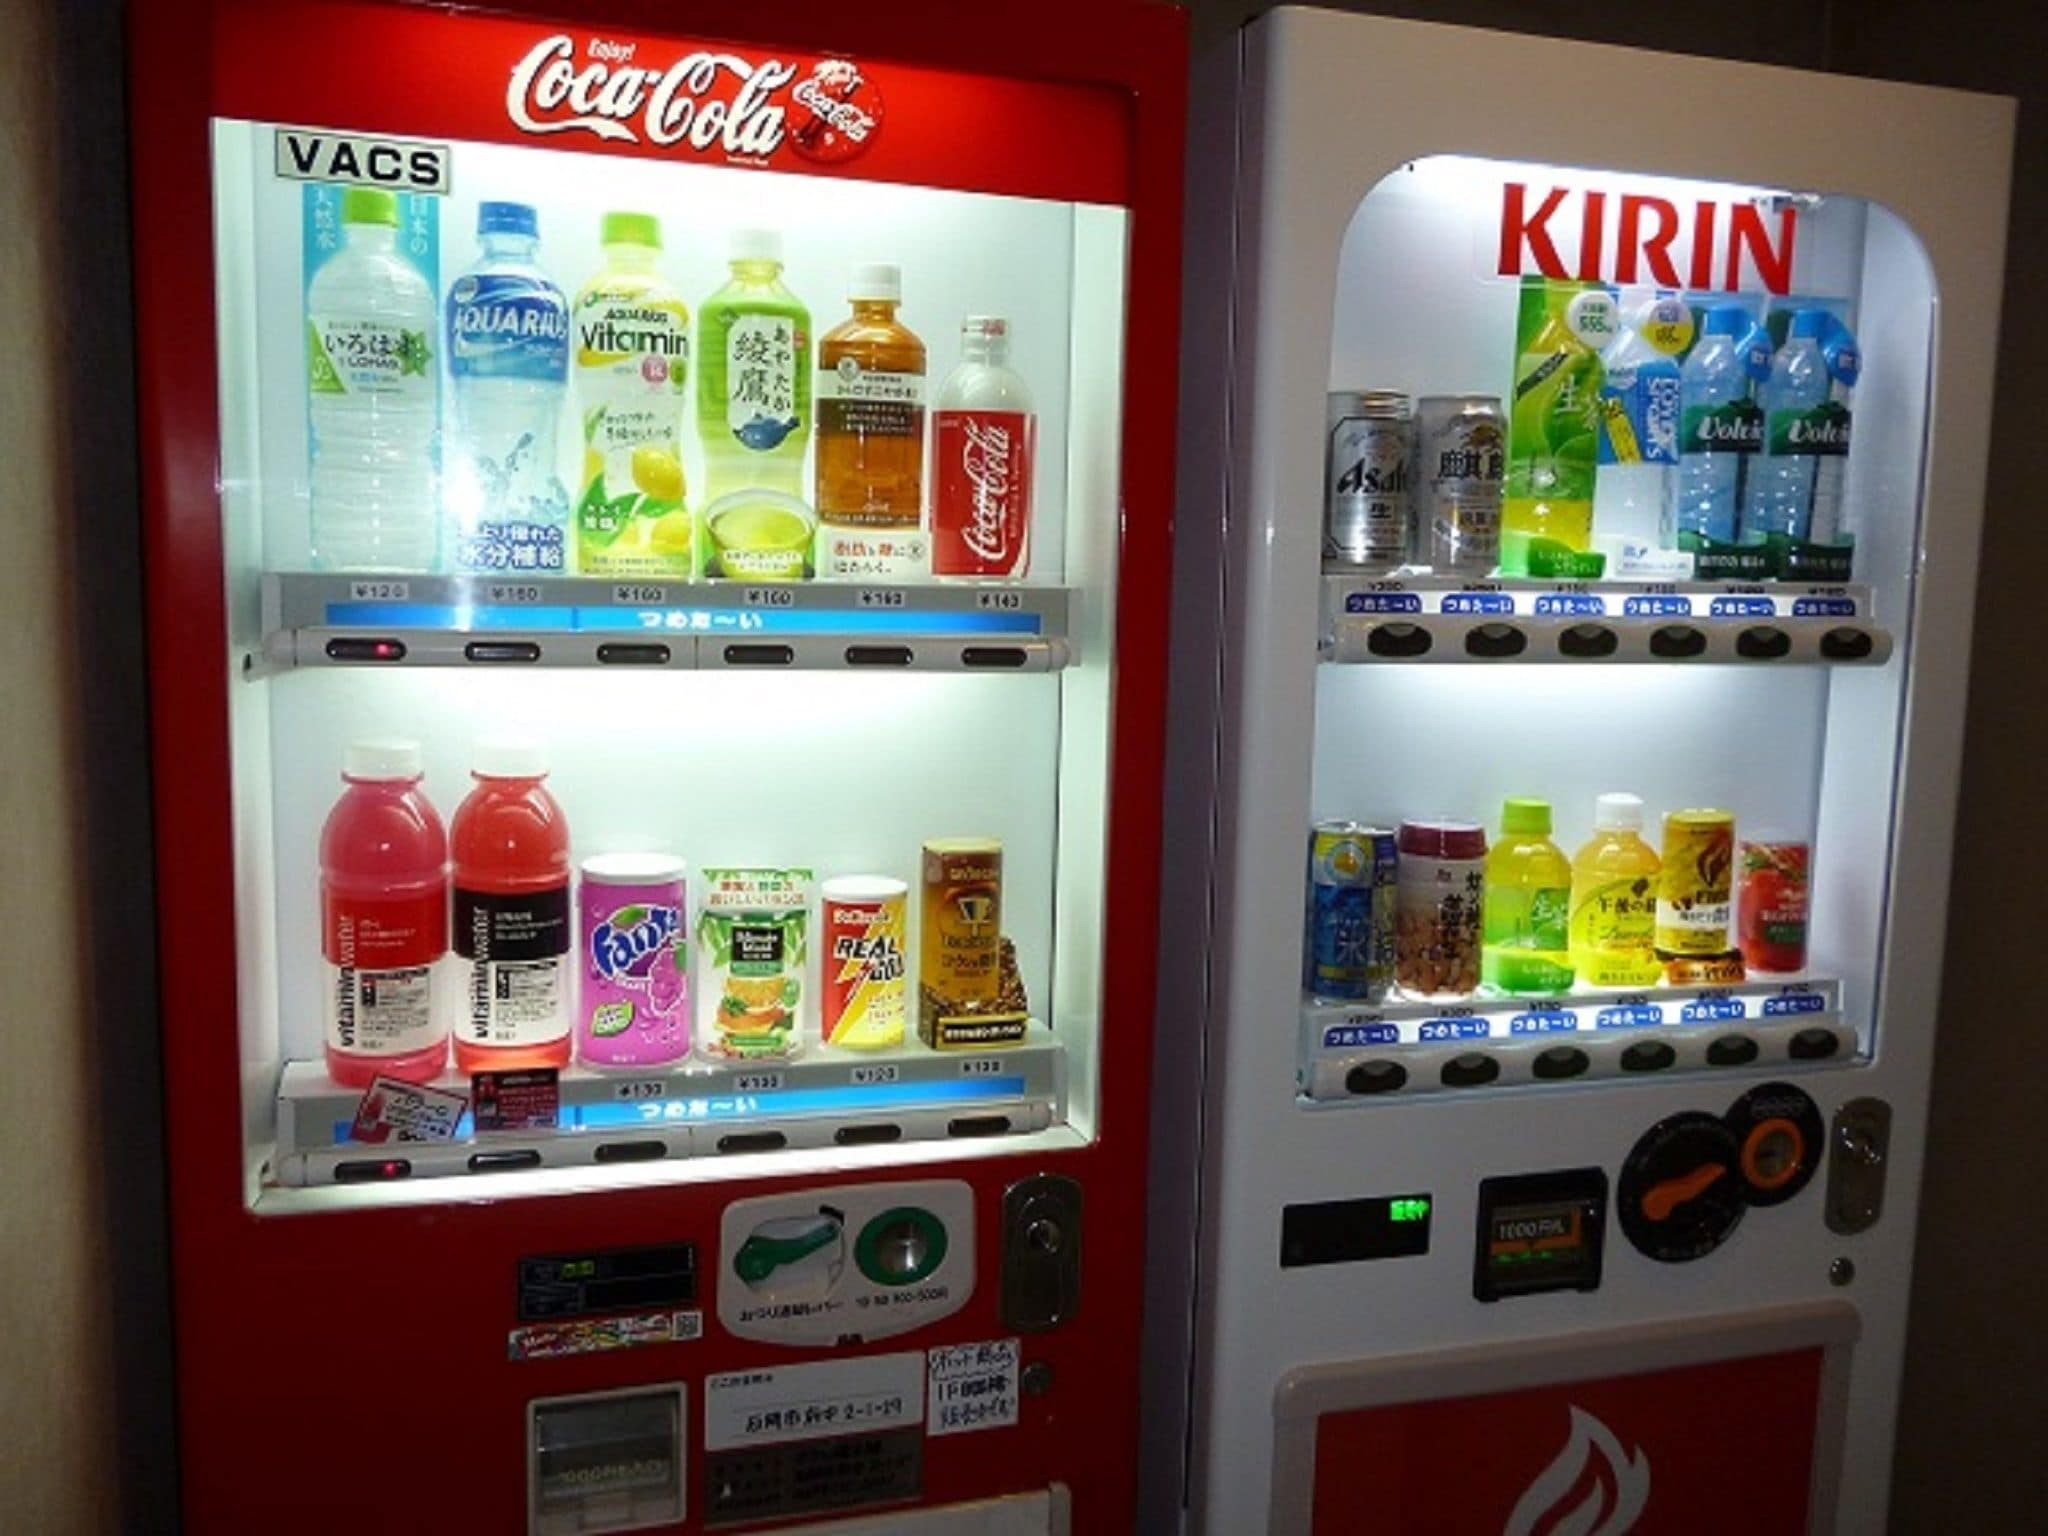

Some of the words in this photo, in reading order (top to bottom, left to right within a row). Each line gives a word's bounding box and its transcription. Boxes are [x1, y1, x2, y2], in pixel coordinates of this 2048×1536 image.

[507, 34, 798, 156] Coca-Cola
[287, 136, 442, 185] VACS
[1498, 182, 1797, 296] KIRIN
[732, 329, 770, 406] 綾鷹
[960, 415, 1009, 561] Coca-Cola
[833, 934, 901, 957] REAL
